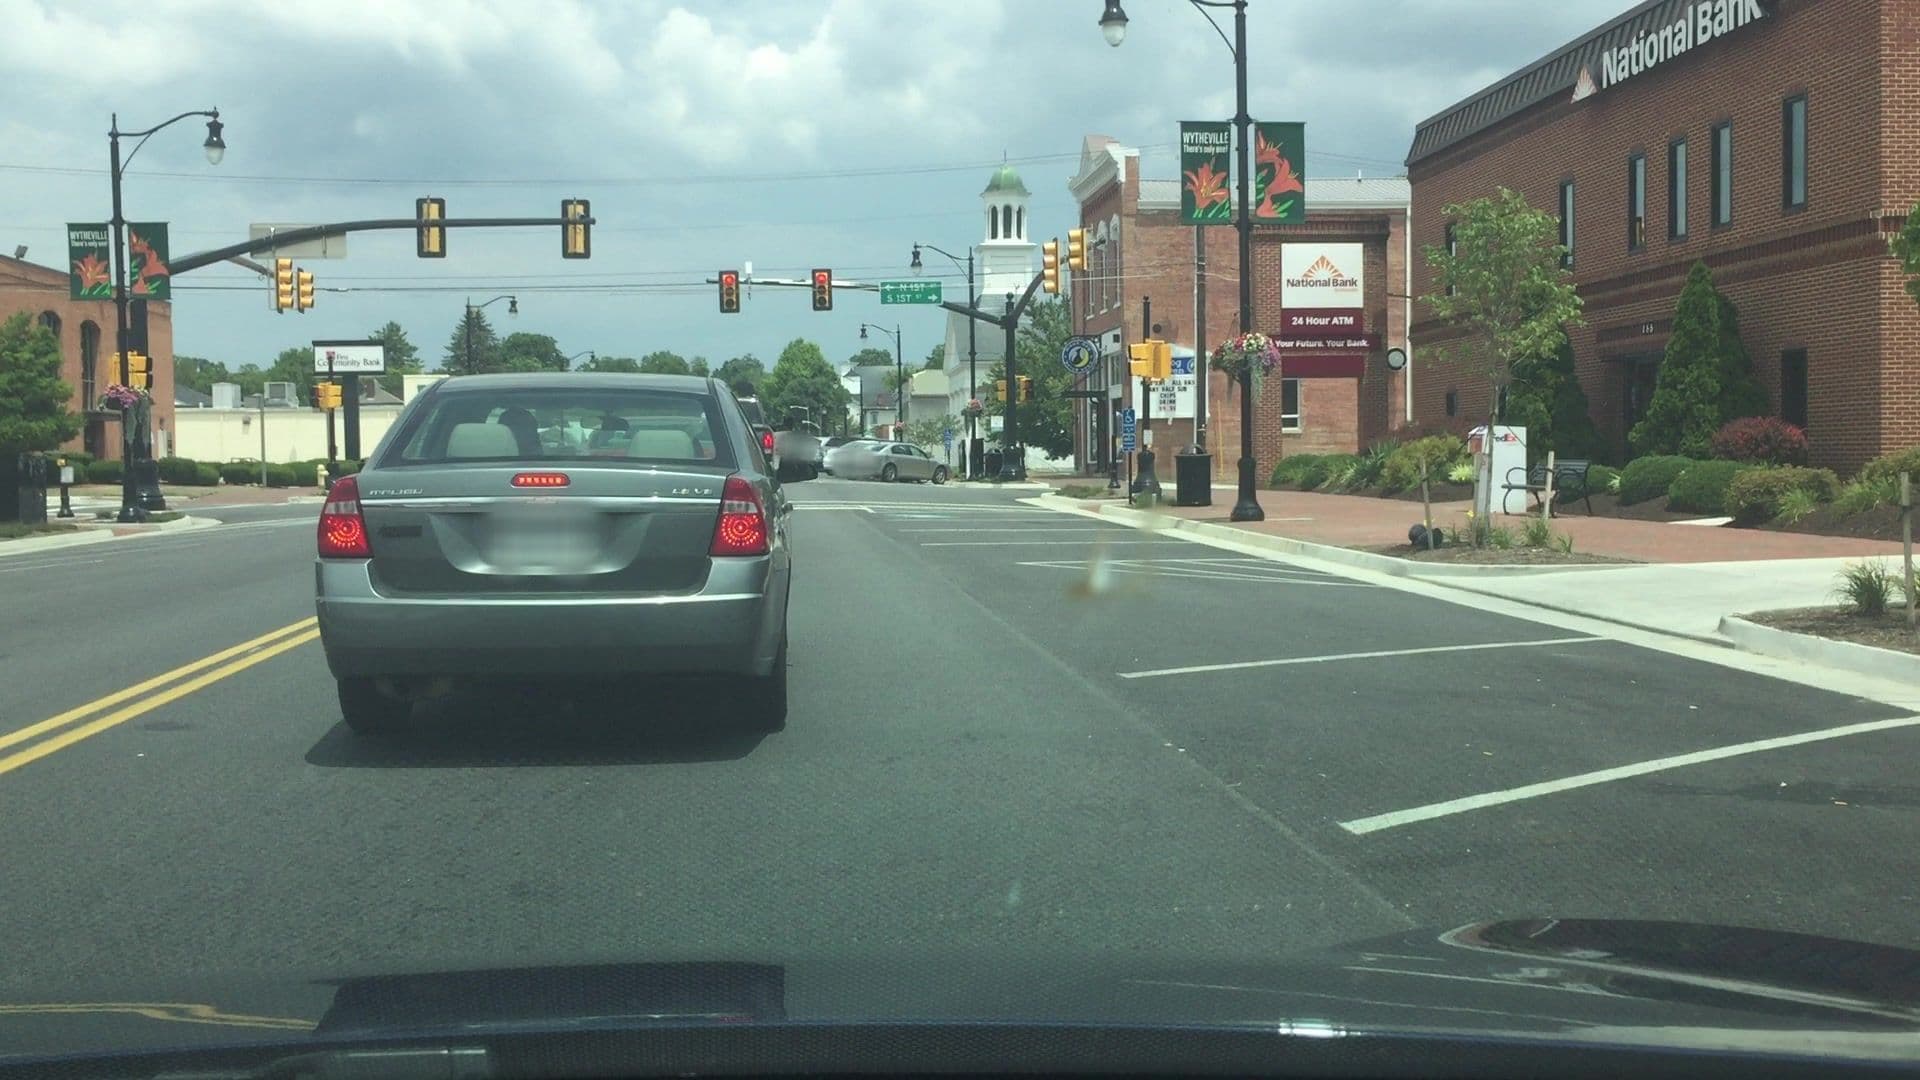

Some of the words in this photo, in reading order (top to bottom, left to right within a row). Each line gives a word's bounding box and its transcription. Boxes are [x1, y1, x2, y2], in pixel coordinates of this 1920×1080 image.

[1601, 5, 1694, 89] National
[1696, 0, 1762, 46] Bank
[1182, 131, 1229, 144] WYTHEVILLE
[1183, 144, 1203, 153] There's
[1203, 145, 1215, 155] only
[69, 230, 108, 241] WYTHEVILLE
[899, 283, 907, 292] N
[910, 283, 925, 292] 1ST
[1286, 277, 1331, 288] National
[1332, 277, 1358, 288] Bank
[887, 294, 893, 303] S
[896, 294, 912, 303] 1ST
[1291, 316, 1304, 326] 24
[1305, 316, 1330, 326] Hour
[1331, 316, 1354, 325] ATM
[1274, 339, 1294, 348] Your
[1295, 339, 1325, 348] Future.
[1326, 339, 1345, 348] Your
[1346, 339, 1370, 347] Bank.
[317, 359, 361, 368] Comunity
[363, 358, 381, 366] Bank
